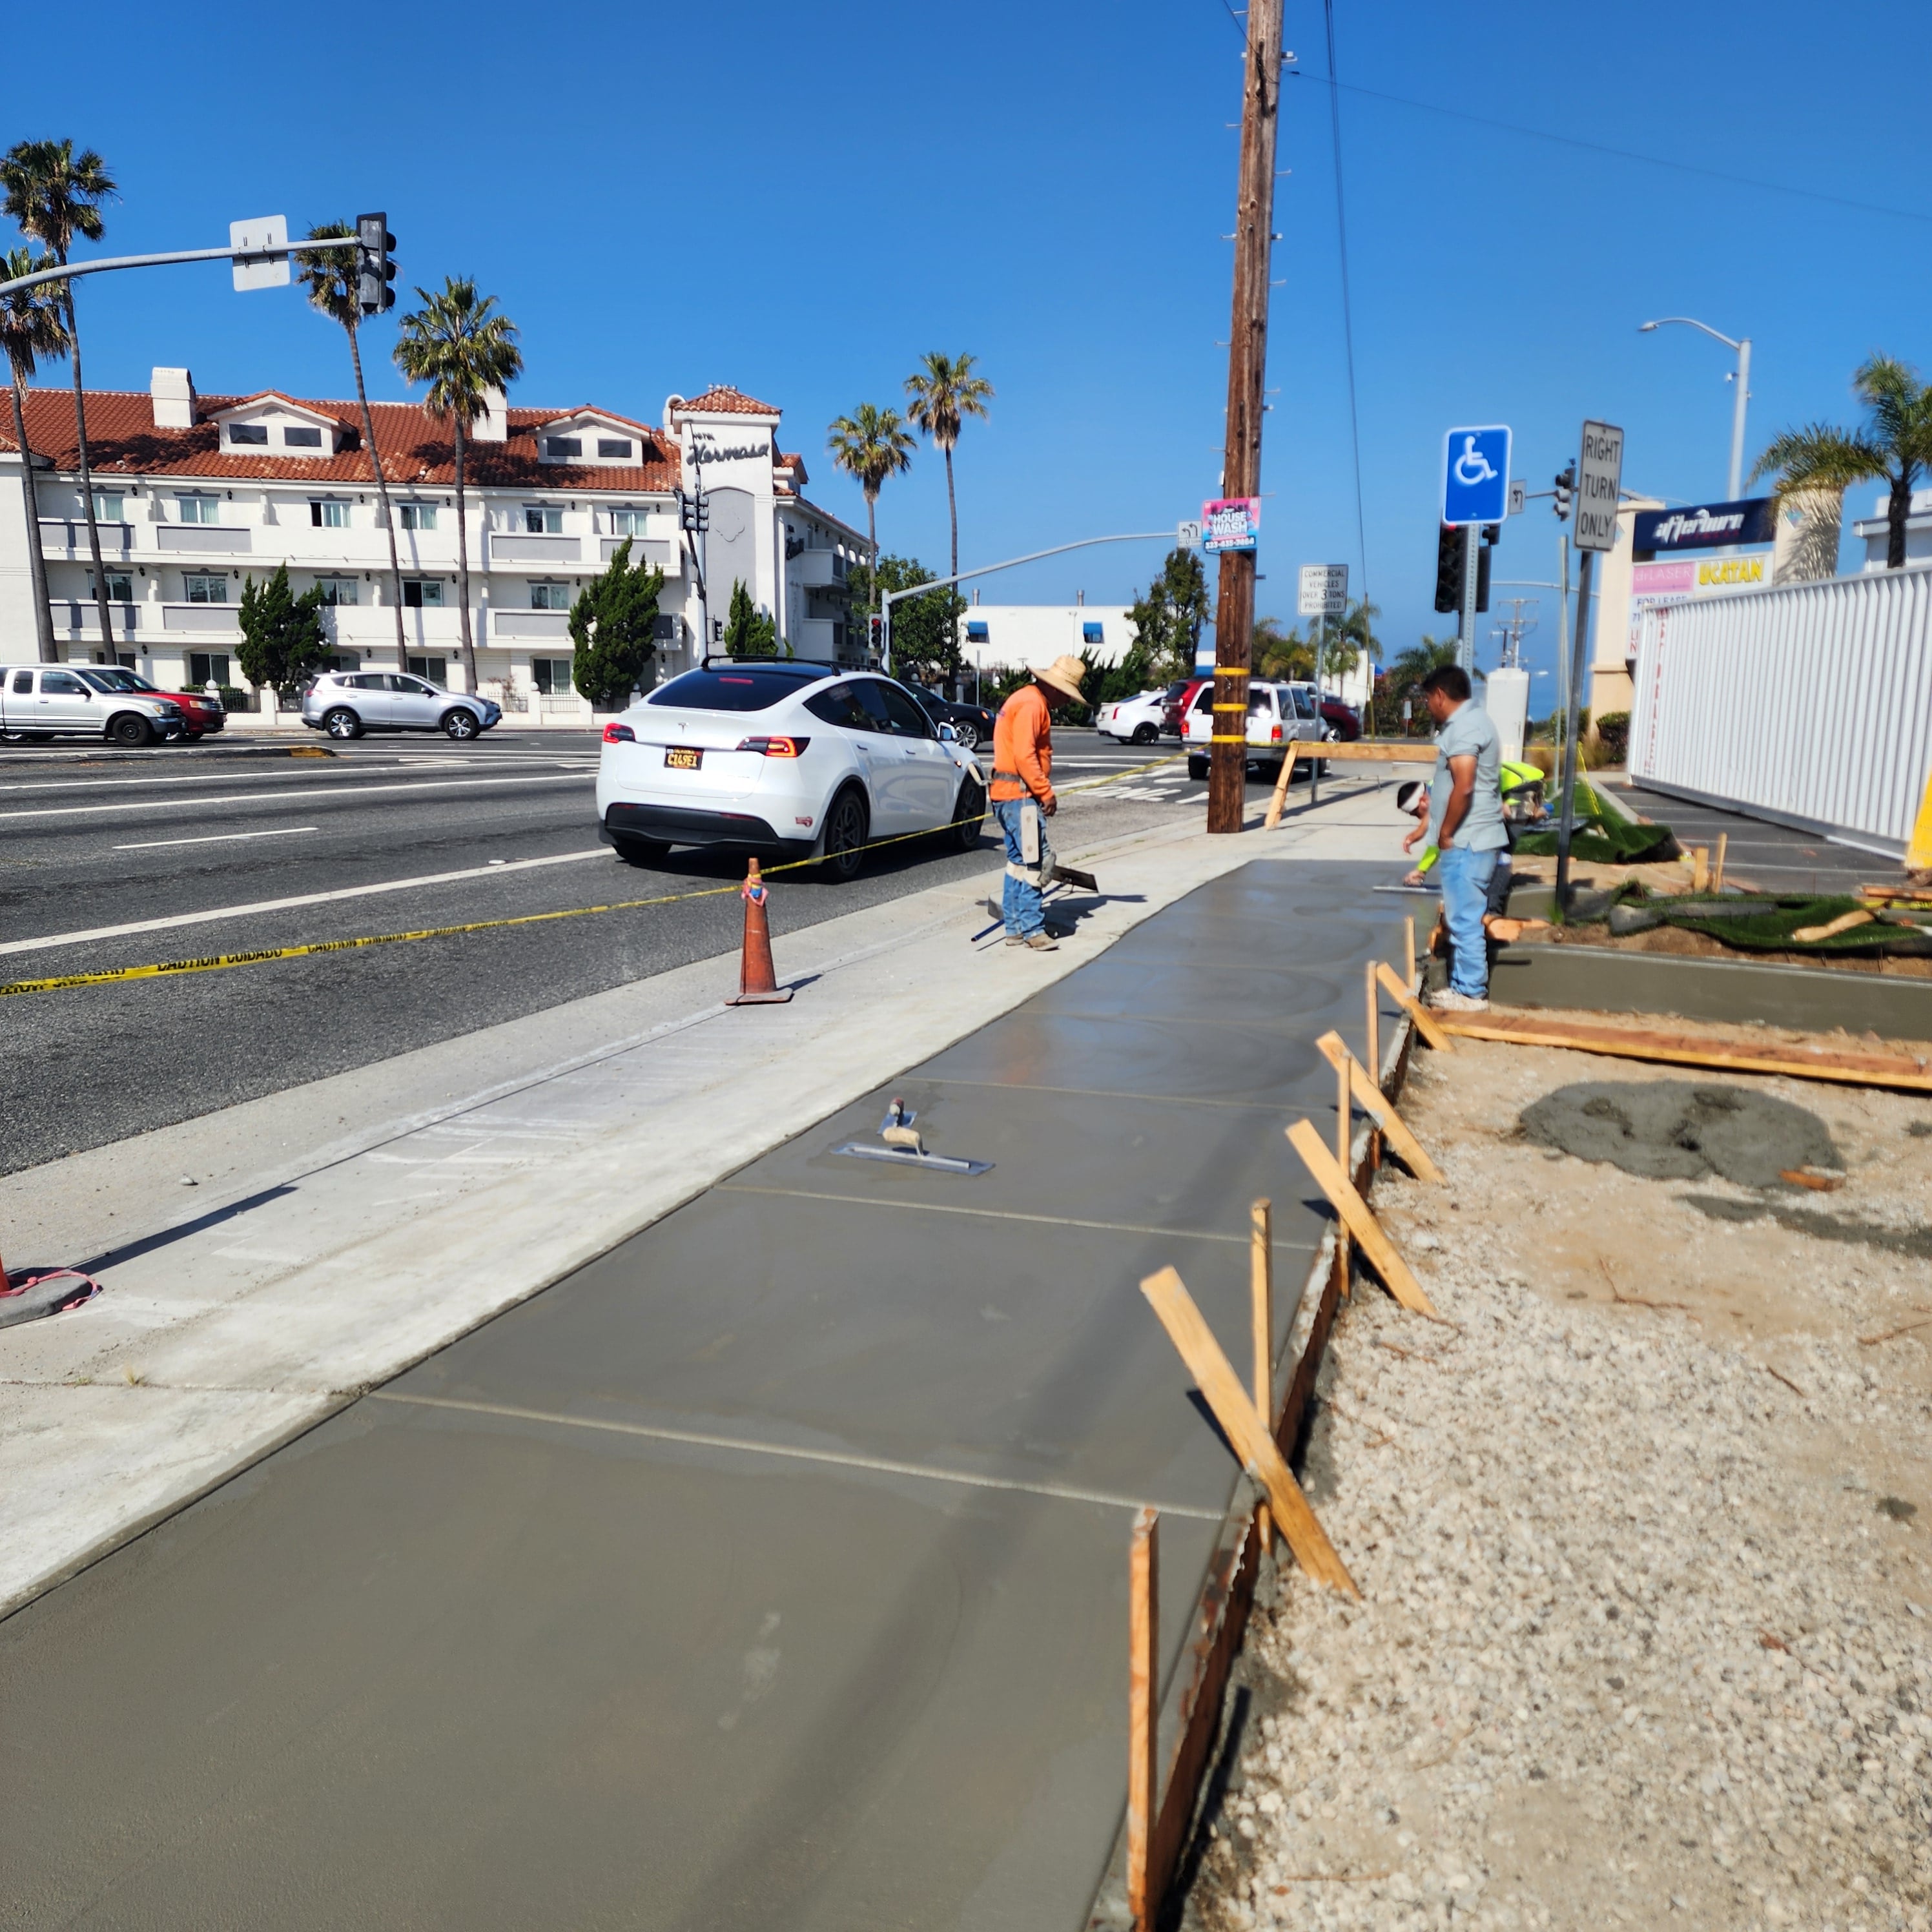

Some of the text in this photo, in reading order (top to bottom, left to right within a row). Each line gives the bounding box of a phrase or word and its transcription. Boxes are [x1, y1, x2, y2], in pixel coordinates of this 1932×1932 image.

[1585, 435, 1619, 463] RIGHT
[1585, 473, 1616, 500] TURN
[1213, 511, 1246, 524] HOUSE
[1581, 512, 1612, 537] ONLY
[1213, 520, 1248, 536] WASH
[1321, 589, 1328, 600] 3
[1330, 590, 1345, 599] TONS
[1304, 601, 1342, 610] PROHIBITED
